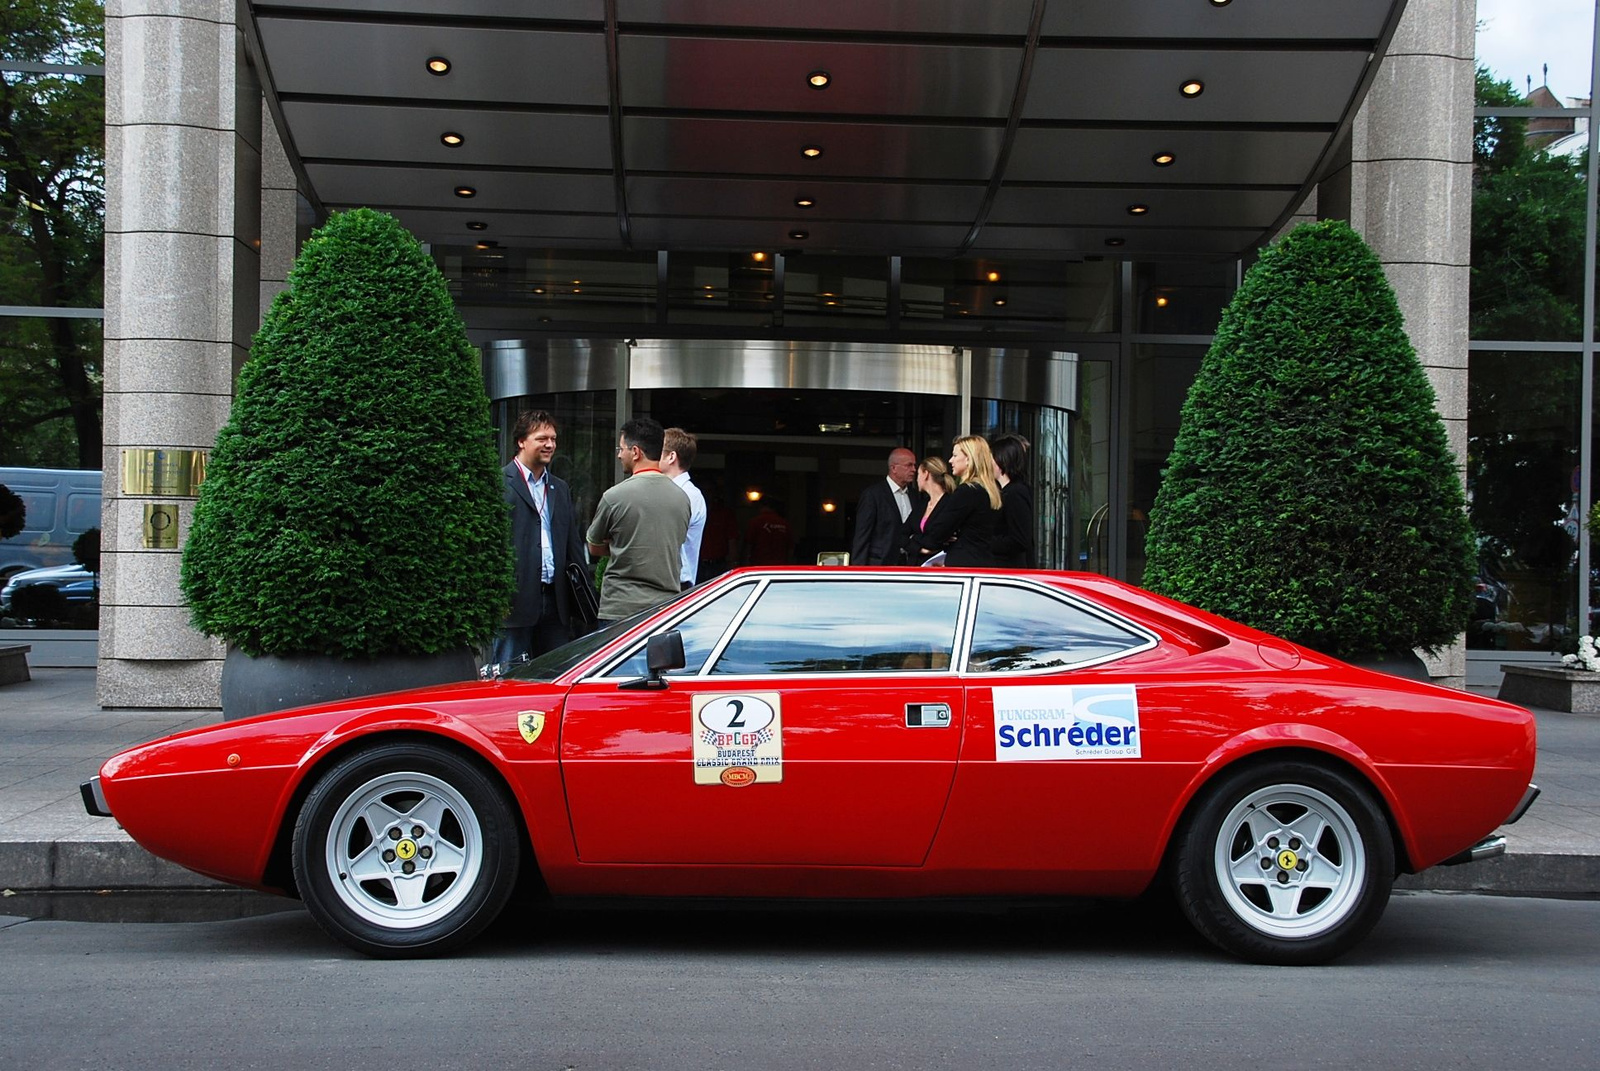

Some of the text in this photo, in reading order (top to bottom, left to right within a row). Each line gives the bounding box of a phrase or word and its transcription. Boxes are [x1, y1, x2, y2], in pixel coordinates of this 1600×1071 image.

[726, 699, 746, 728] 2
[998, 708, 1072, 721] TUNGSRAM-
[717, 732, 757, 746] BPCGP
[999, 721, 1136, 748] Schréder
[717, 749, 755, 758] BUDAPEST
[696, 757, 780, 767] CLASSIC GRAND PRIX
